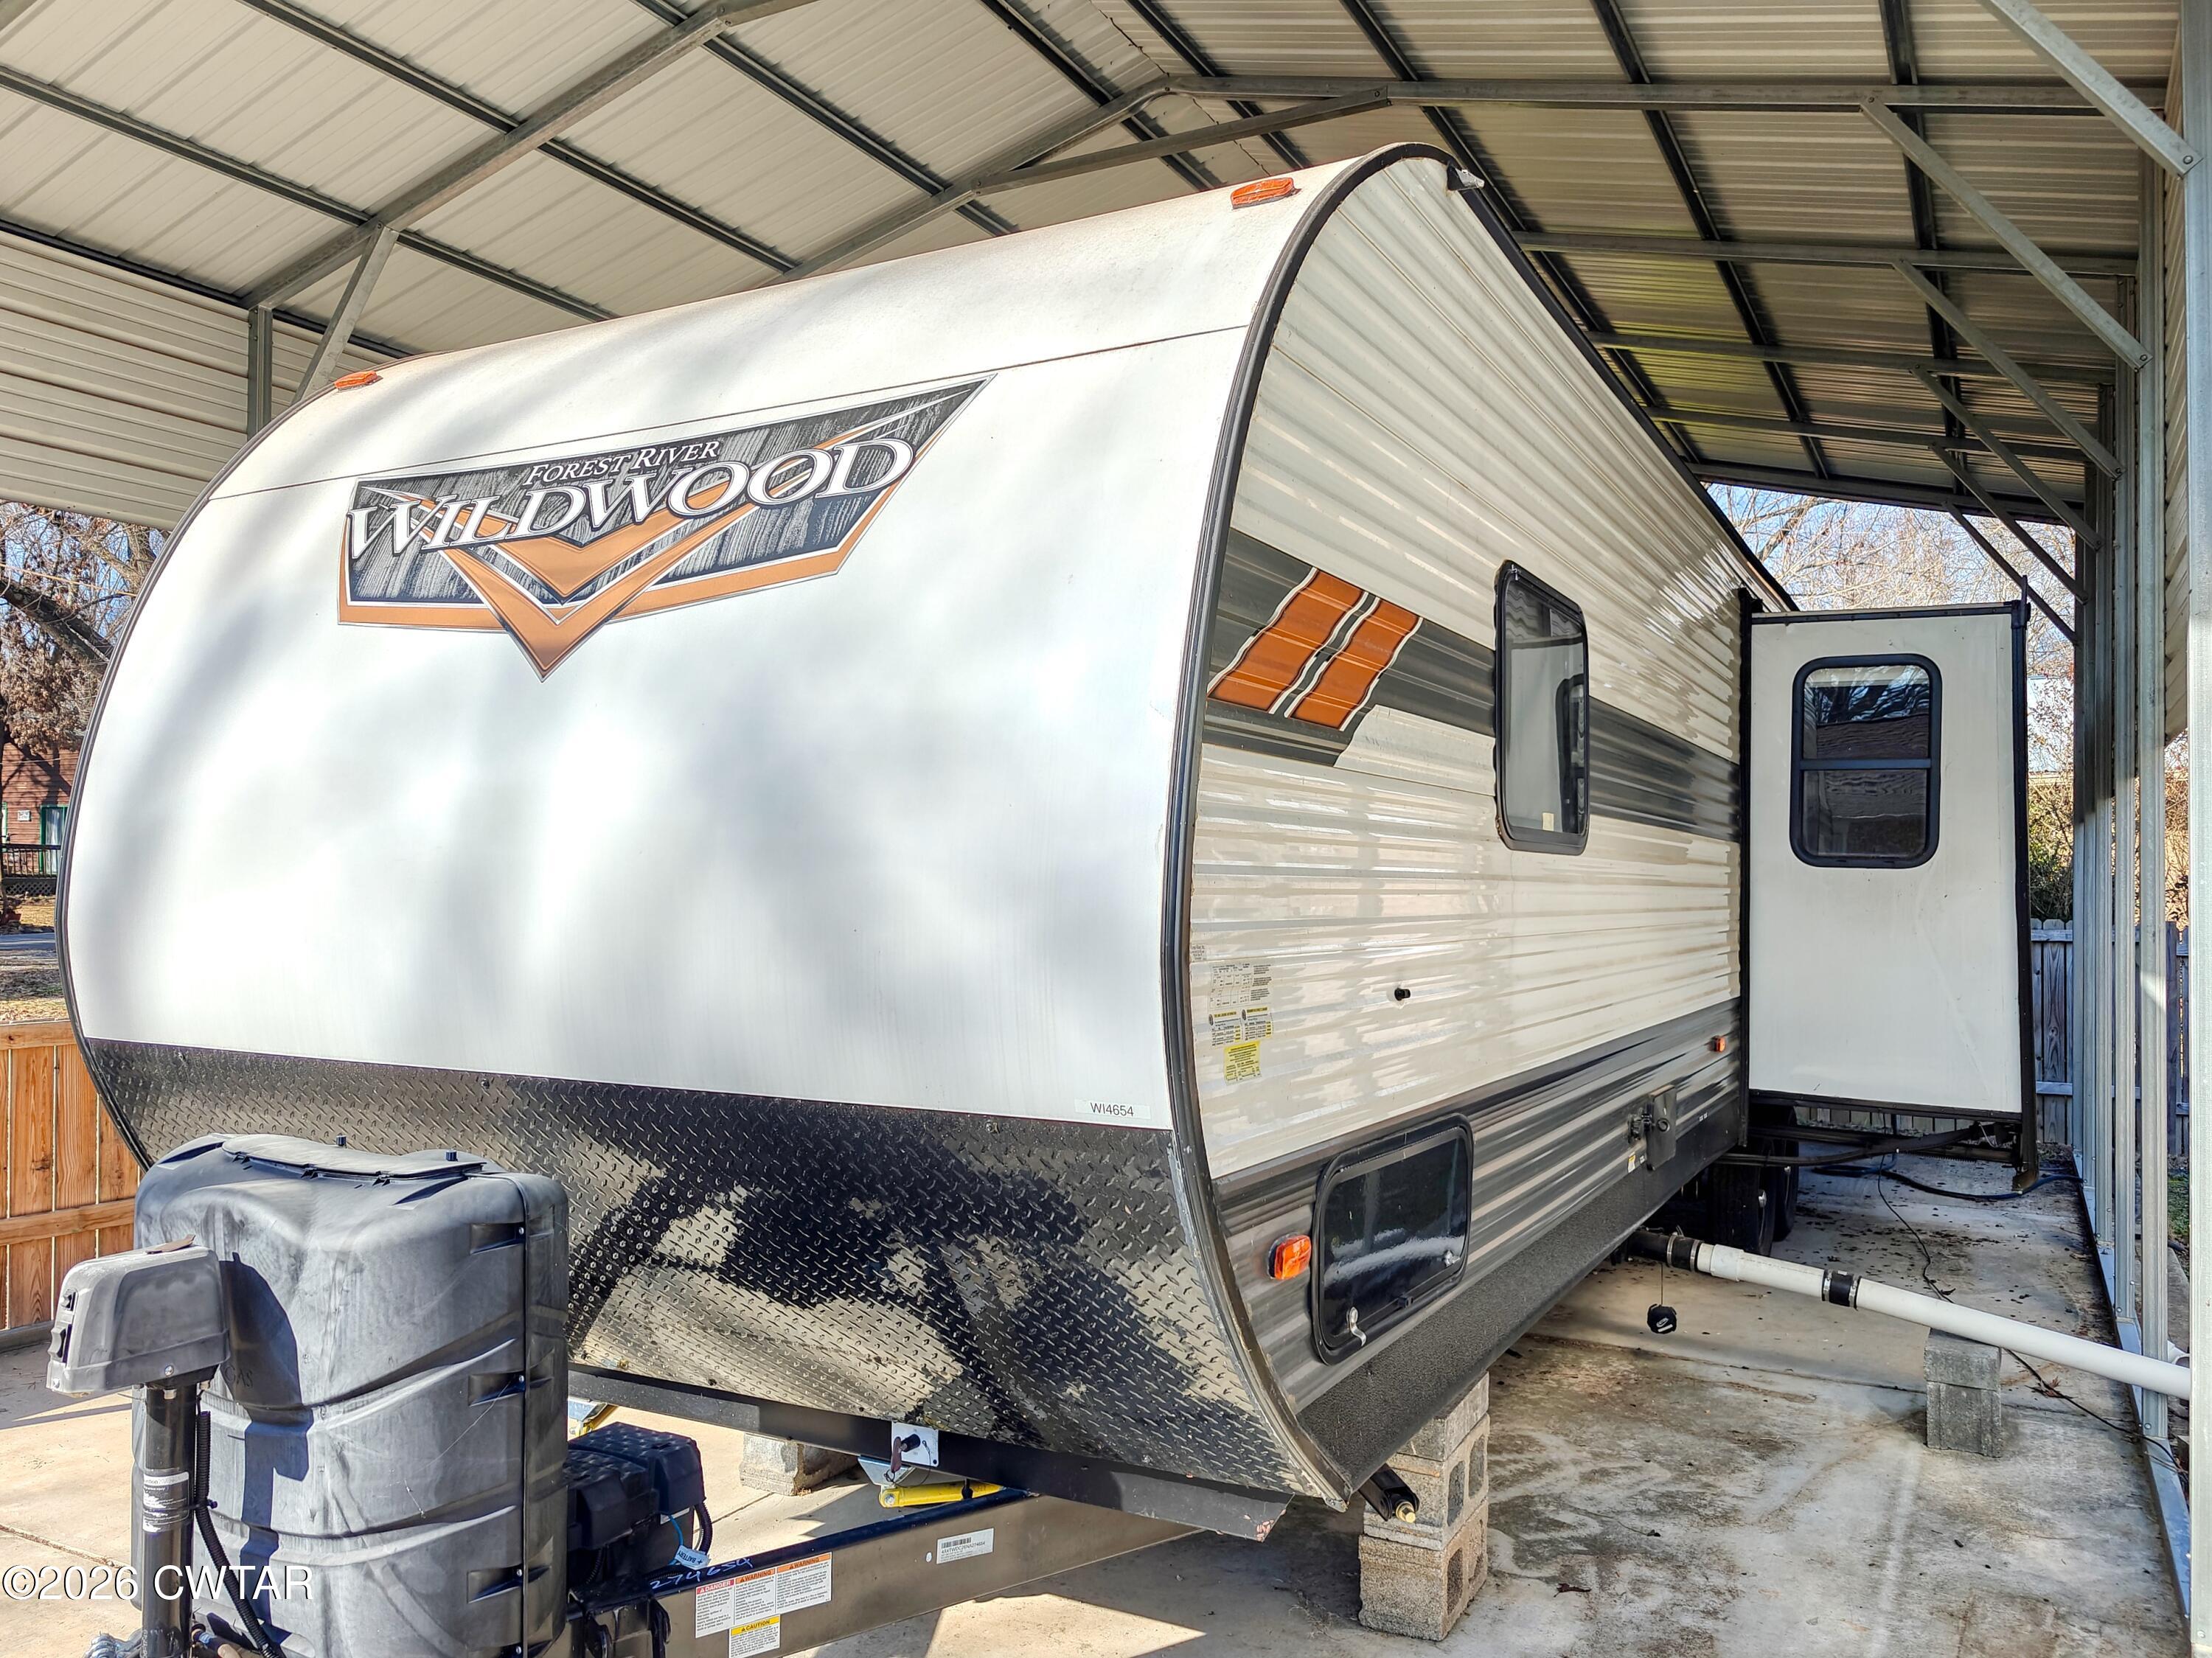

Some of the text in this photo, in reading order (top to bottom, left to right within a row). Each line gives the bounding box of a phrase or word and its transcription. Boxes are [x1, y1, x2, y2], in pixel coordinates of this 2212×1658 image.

[525, 440, 720, 486] FOREST RIVER
[349, 437, 917, 560] WILDWOOD
[1090, 1101, 1134, 1117] WI4654
[678, 1550, 696, 1563] BATTERY
[794, 1558, 819, 1568] WARNING
[745, 1570, 771, 1581] WARNING
[705, 1581, 731, 1591] DANGER
[746, 1620, 771, 1631] CAUTION
